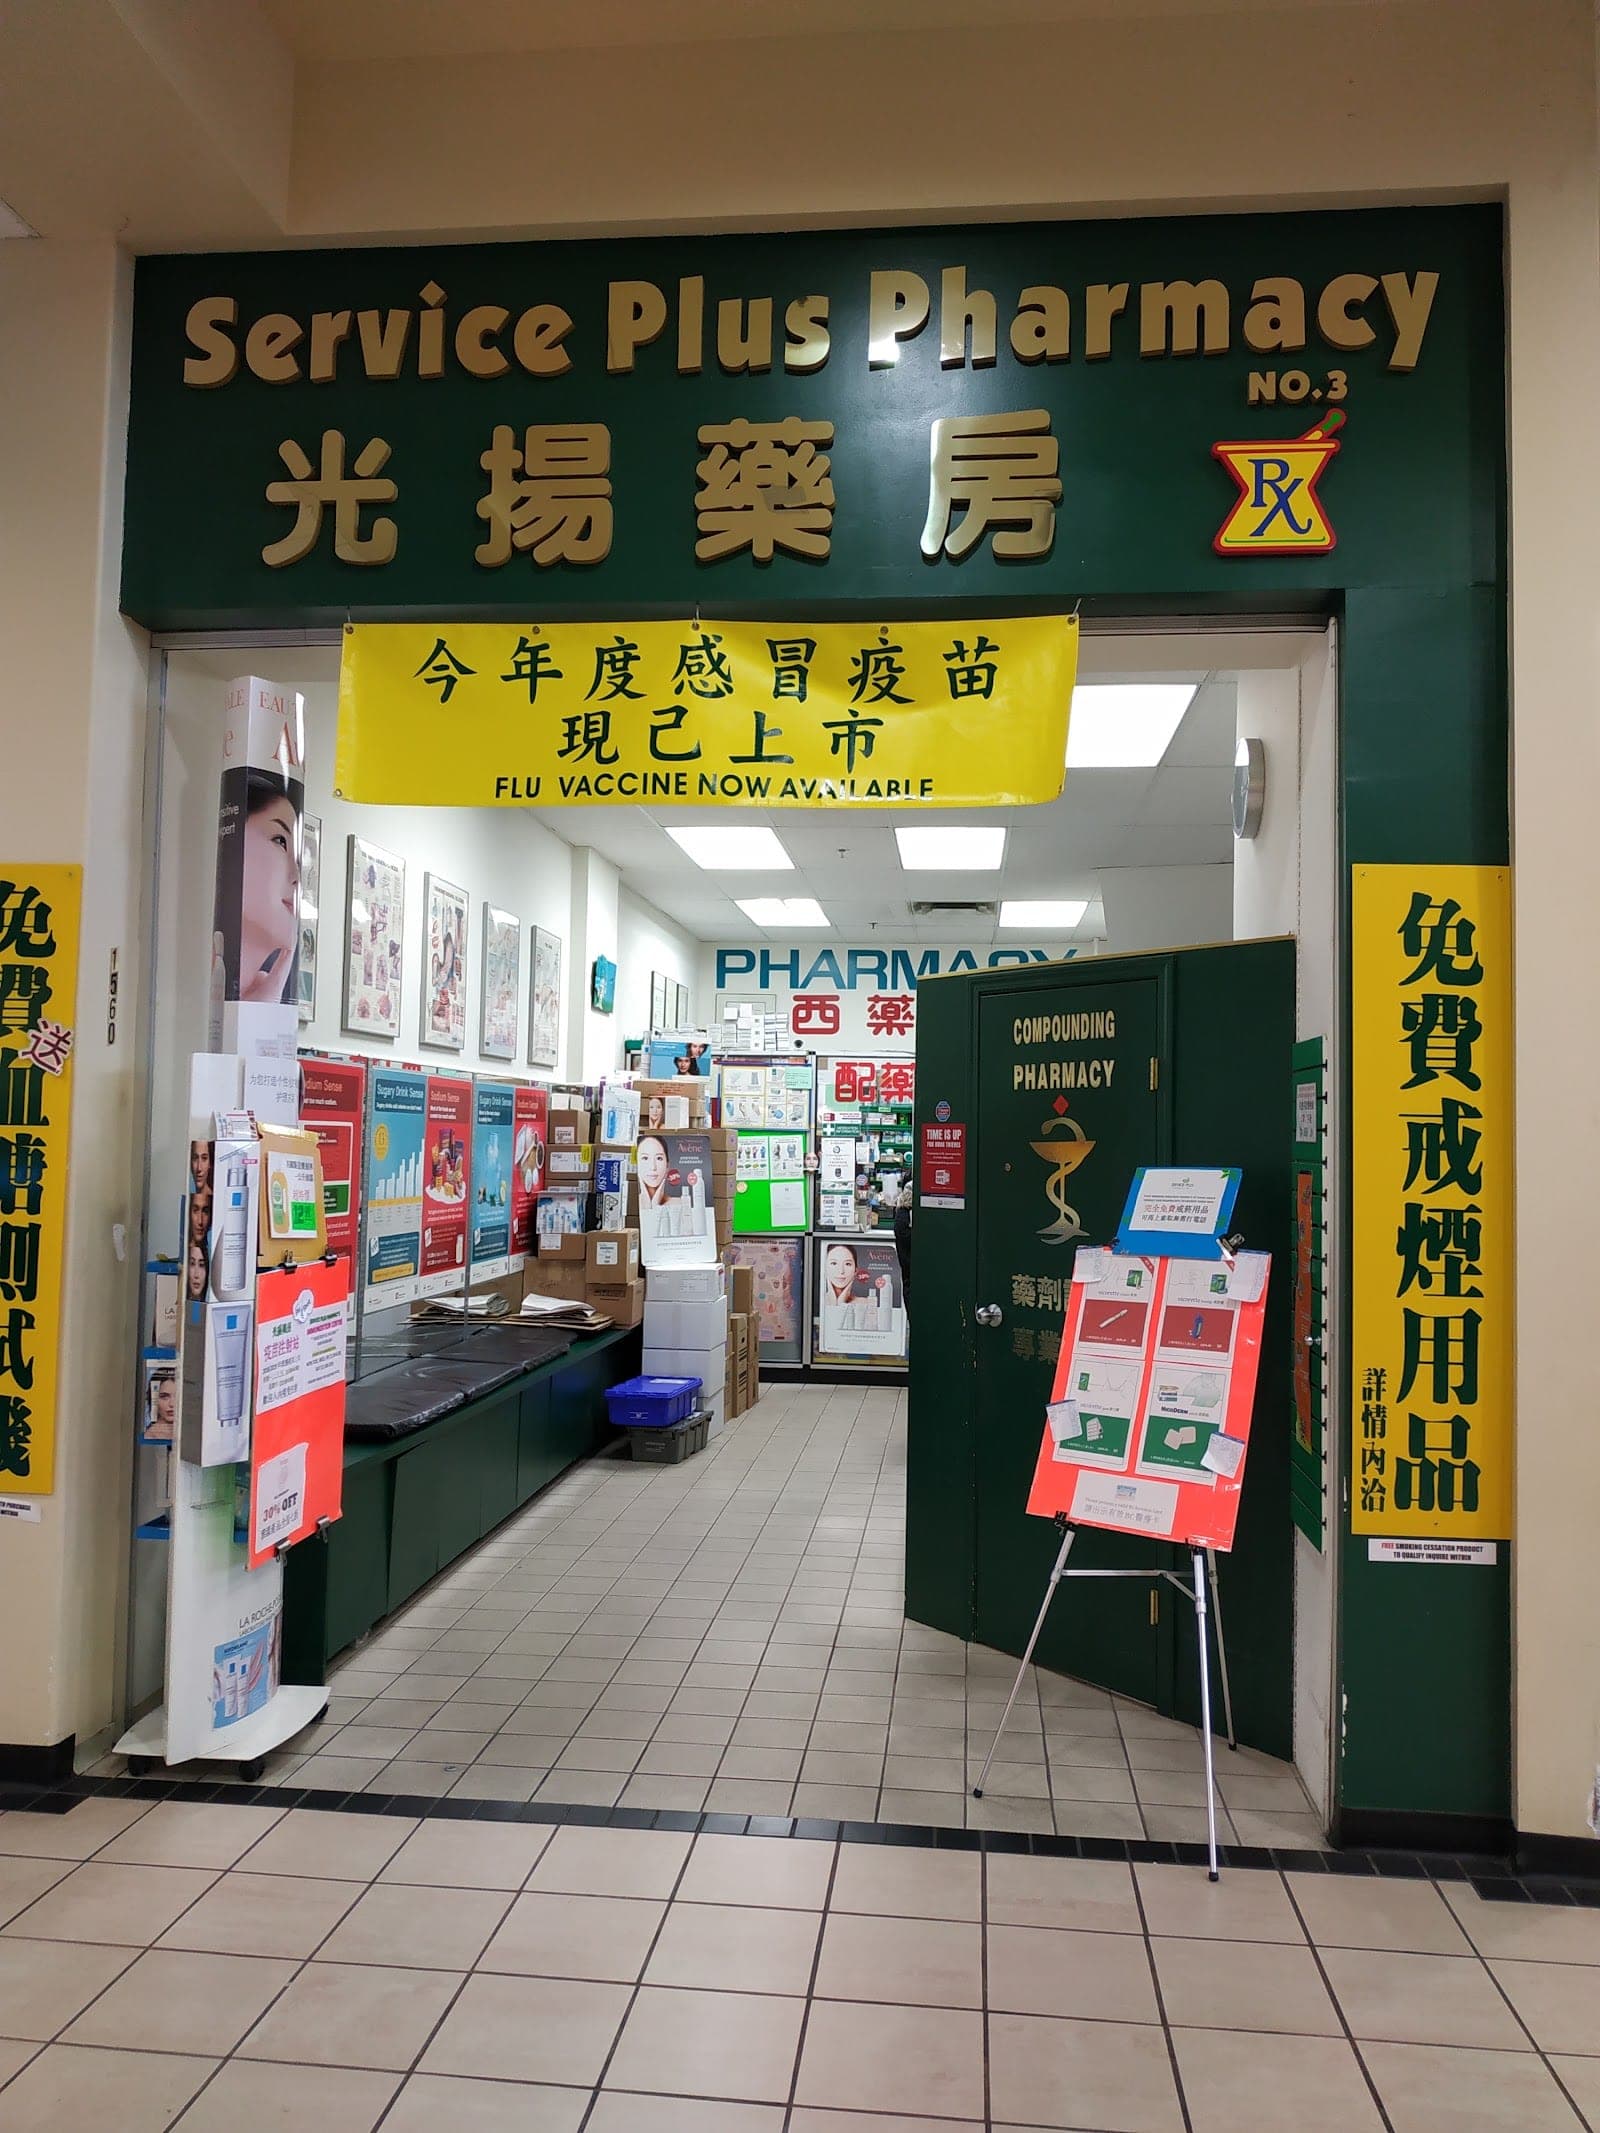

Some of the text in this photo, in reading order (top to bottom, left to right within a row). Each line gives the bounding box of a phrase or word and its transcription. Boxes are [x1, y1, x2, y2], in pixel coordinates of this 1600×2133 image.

[183, 264, 1441, 389] Service Plus Pharmacy
[1247, 370, 1349, 405] NO.3
[261, 409, 1062, 570] 光揚藥房
[412, 634, 1000, 704] 今年度感冒疫苗
[494, 772, 934, 800] FLU VACCINE NOW AVAILABLE
[716, 949, 1079, 989] PHARMA
[107, 947, 119, 1045] 1560
[792, 994, 914, 1036] 西藥
[21, 1019, 72, 1075] 送
[1013, 1010, 1116, 1046] COMPOUNDING
[377, 1084, 424, 1099] Sugary Drink Sense
[835, 1062, 915, 1102] 配藥
[1013, 1060, 1115, 1091] PHARMACY
[926, 1129, 962, 1140] TIME IS UP
[1394, 891, 1485, 1512] 免費戒煙用品
[281, 1491, 298, 1511] OFF
[1395, 1543, 1422, 1551] SMOKING
[1423, 1544, 1456, 1552] CESSATION
[1456, 1545, 1484, 1553] PRODUCT
[1401, 1552, 1425, 1560] QUALIFY
